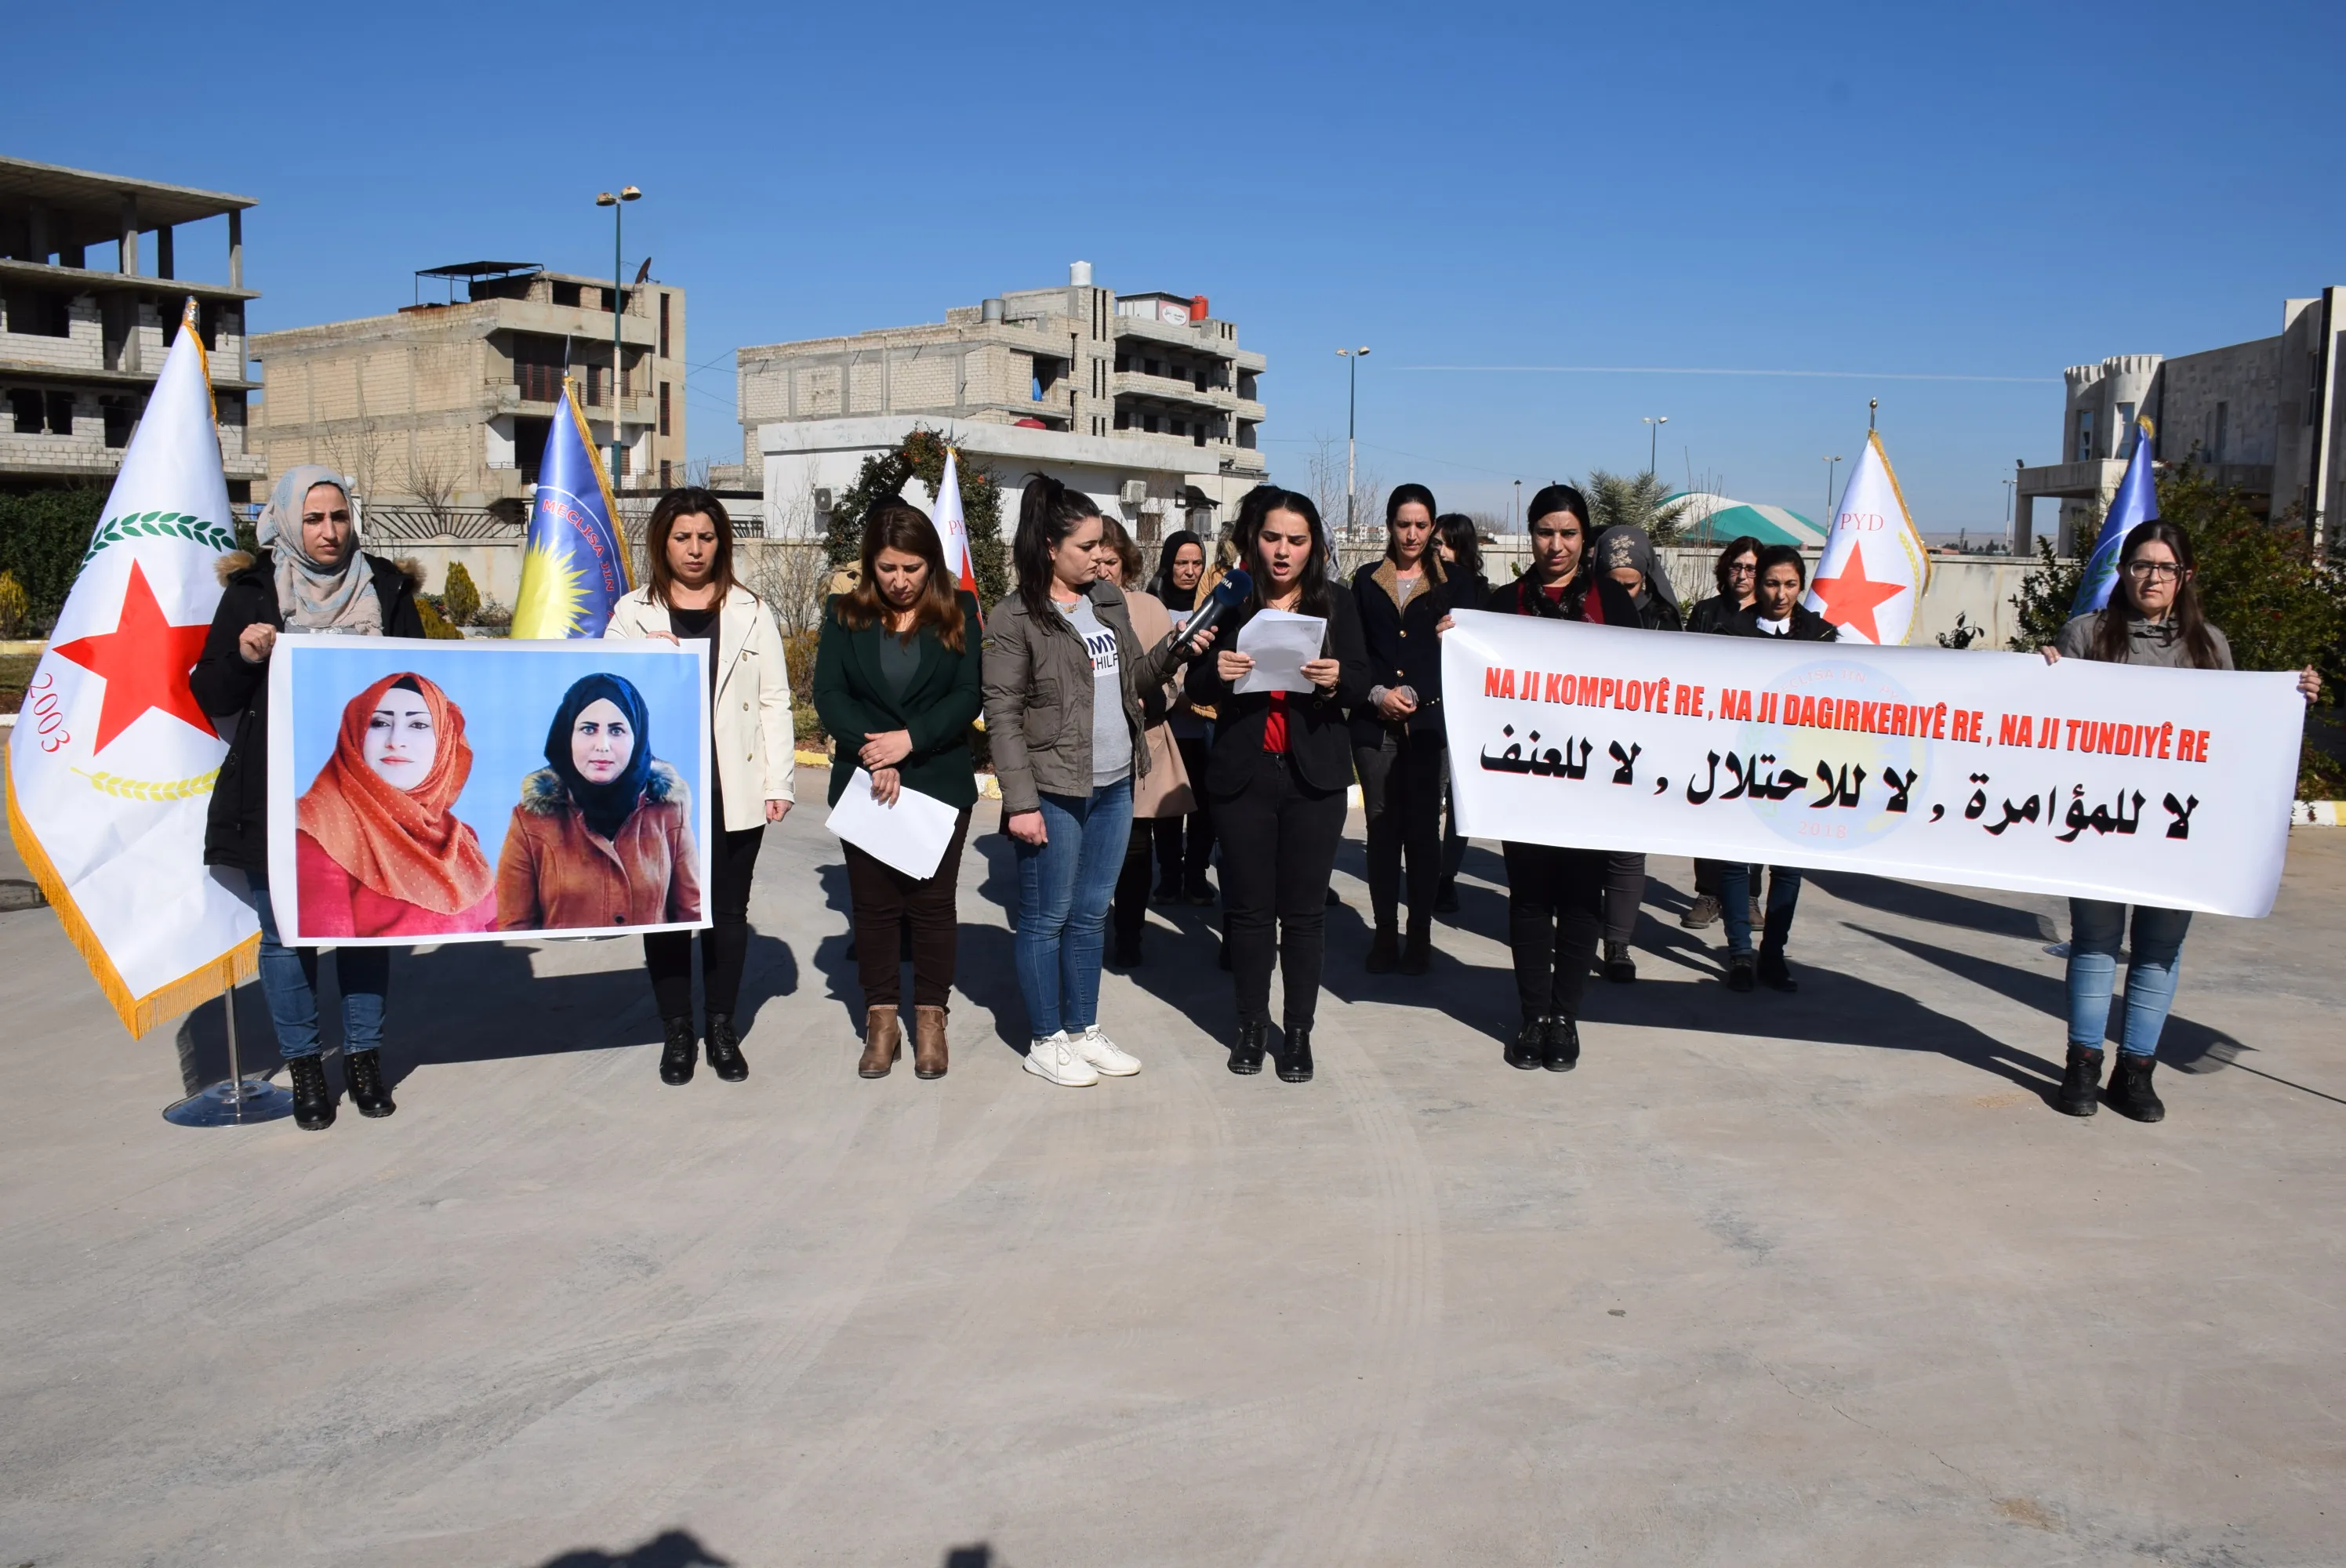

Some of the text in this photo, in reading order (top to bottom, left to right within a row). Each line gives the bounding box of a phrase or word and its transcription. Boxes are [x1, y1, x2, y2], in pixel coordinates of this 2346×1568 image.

[543, 499, 615, 591] MECLISA JIN
[947, 519, 966, 535] PY
[1839, 513, 1884, 532] PYD
[1774, 668, 1835, 696] ECLISA
[30, 673, 71, 753] 2003
[1484, 667, 1516, 699] NA
[1520, 670, 1540, 701] JI
[1545, 673, 1670, 714] KOMPLOYÊ
[1720, 688, 1752, 721] NA
[1757, 691, 1778, 724] JI
[1782, 694, 1948, 739] DAGIRKERIYÊ
[1999, 713, 2032, 747] NA
[2037, 717, 2061, 750] JI
[2066, 719, 2174, 759] TUNDIYÊ
[2176, 728, 2210, 762] RE
[1480, 724, 1593, 780] للعنف
[1608, 740, 1642, 785] لا
[1686, 750, 1868, 808] للاحتلال
[1883, 766, 1918, 813] لا
[1797, 821, 1848, 839] 2018
[1963, 772, 2146, 843] للمؤامرة
[2163, 792, 2199, 840] لا
